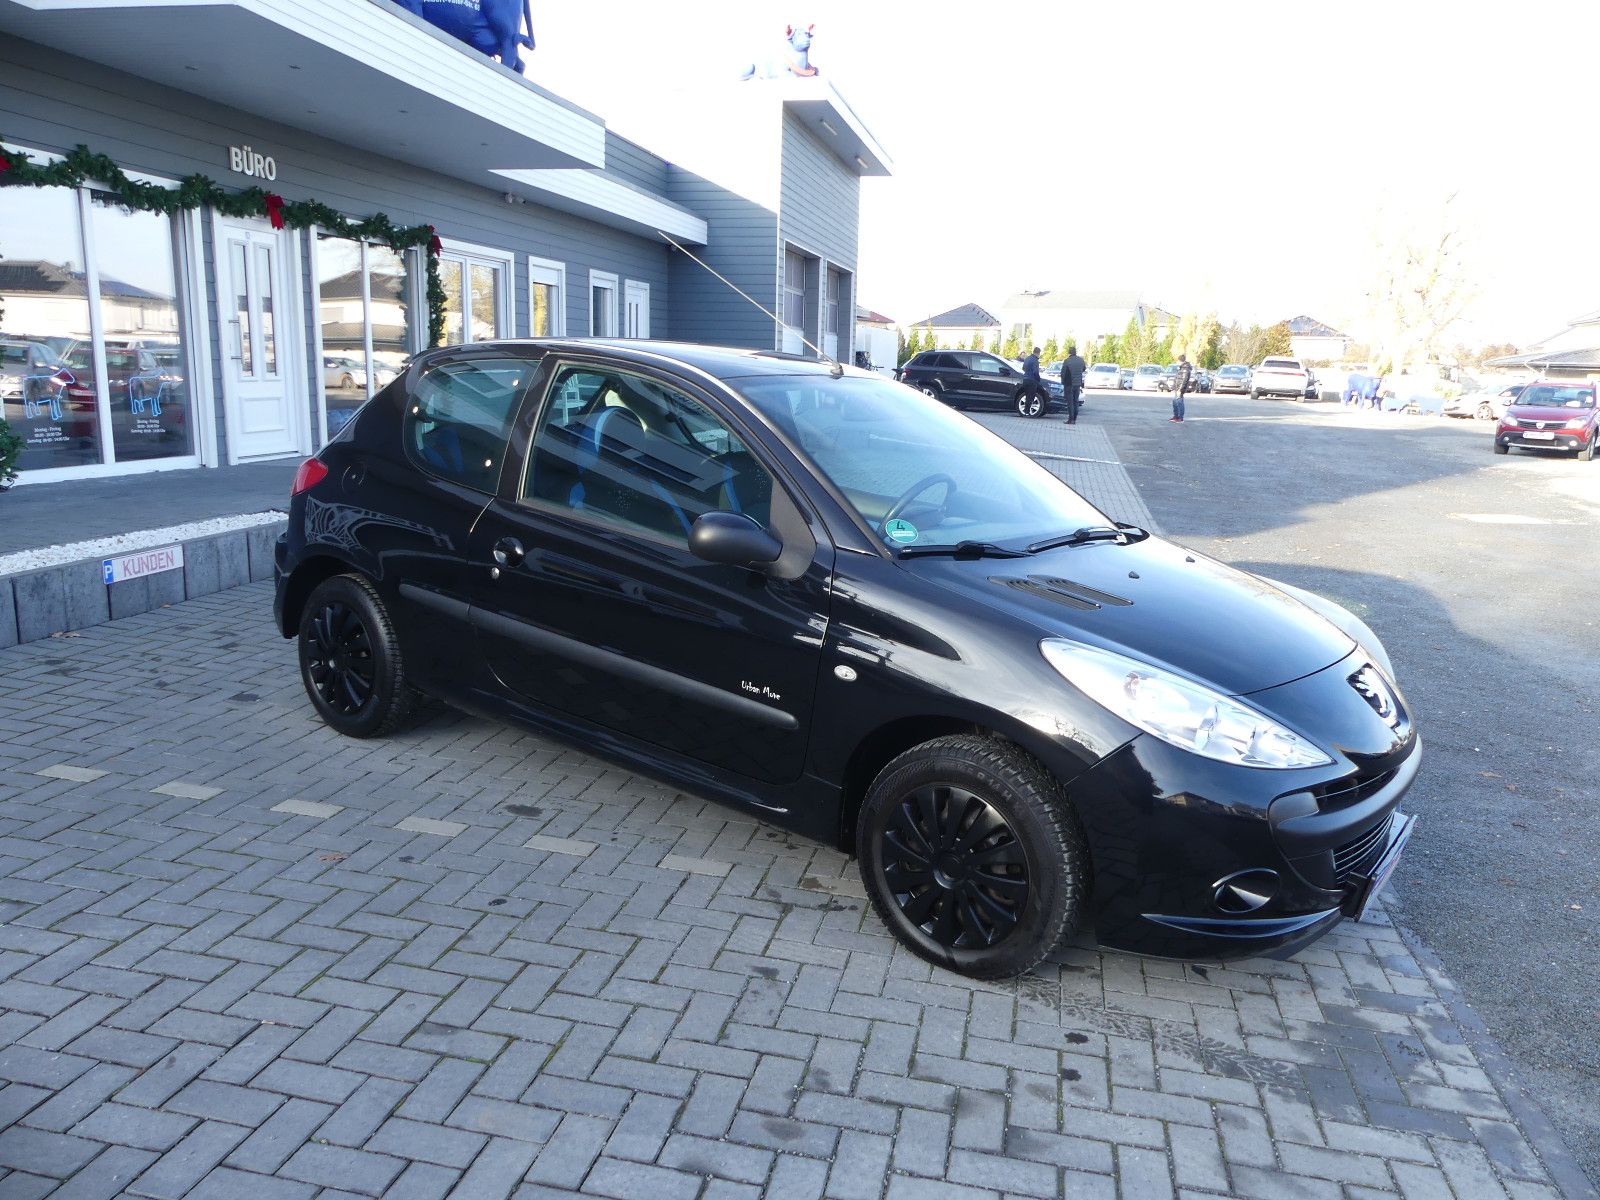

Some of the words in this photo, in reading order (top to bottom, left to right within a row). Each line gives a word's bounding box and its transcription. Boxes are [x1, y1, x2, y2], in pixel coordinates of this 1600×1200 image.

[230, 145, 276, 180] BÜRO
[896, 521, 906, 531] 4
[104, 565, 113, 579] P
[122, 550, 175, 577] KUNDEN
[741, 680, 760, 694] Urban
